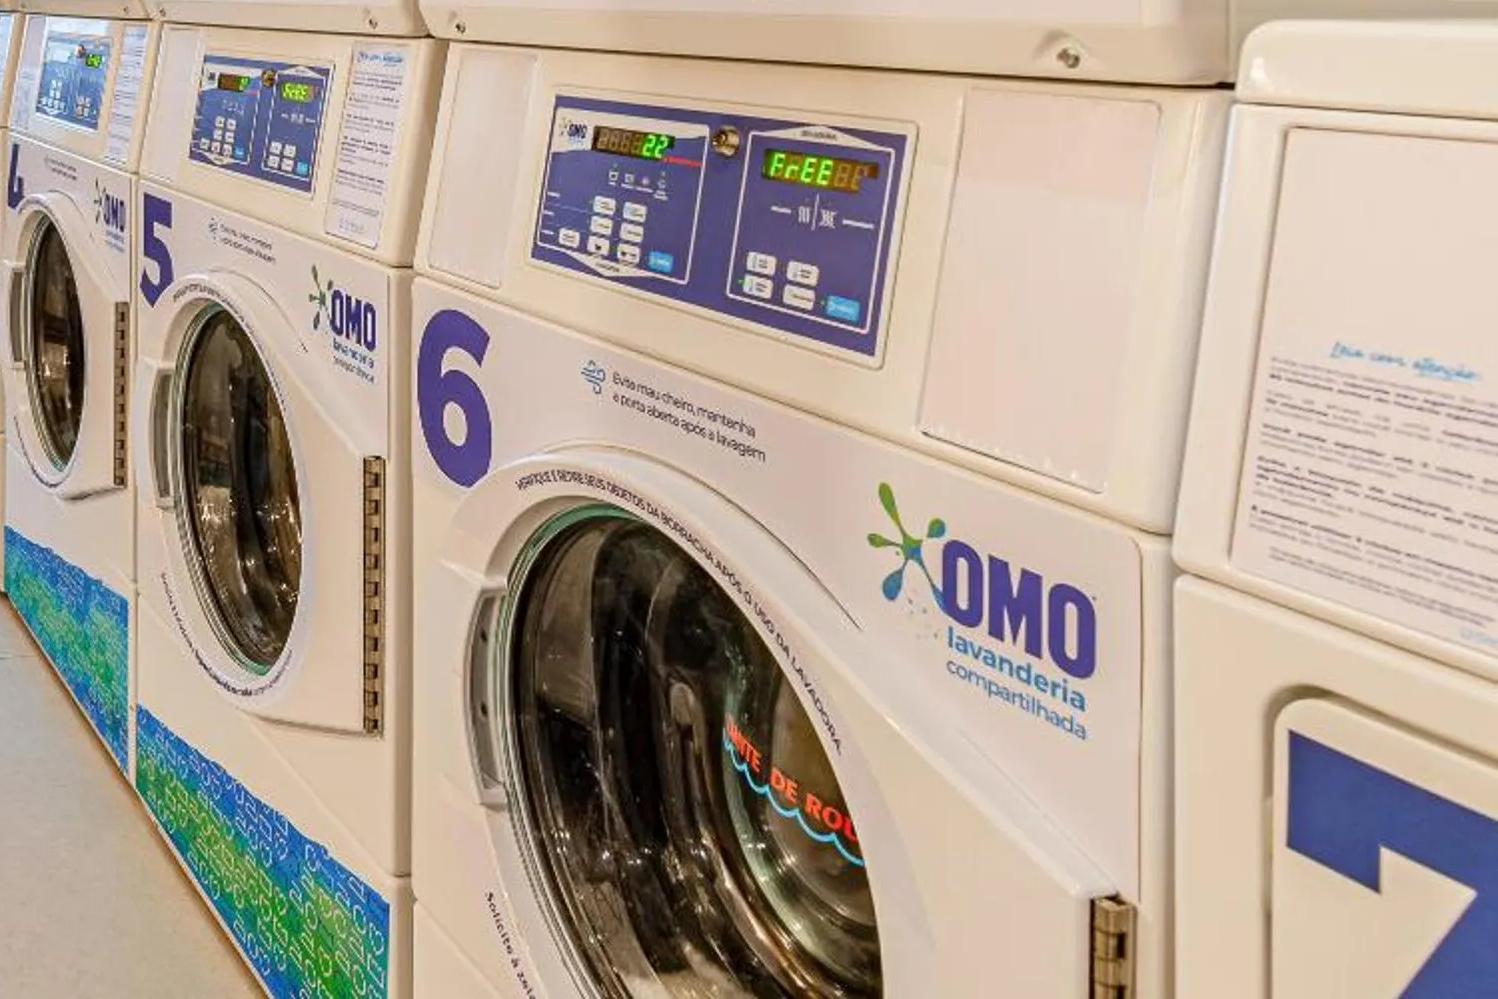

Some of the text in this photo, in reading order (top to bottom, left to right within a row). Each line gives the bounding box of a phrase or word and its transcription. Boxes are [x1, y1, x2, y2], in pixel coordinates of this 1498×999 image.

[642, 134, 670, 158] 22
[140, 193, 175, 309] 5
[330, 289, 377, 353] OMO
[417, 308, 493, 489] 6
[696, 405, 756, 438] mantenha
[716, 431, 766, 463] lavagem
[942, 539, 1096, 679] OMO
[791, 656, 843, 757] LAVADORA
[946, 625, 1087, 713] lavanderia
[946, 658, 1088, 741] compartilhada
[770, 766, 798, 804] DE
